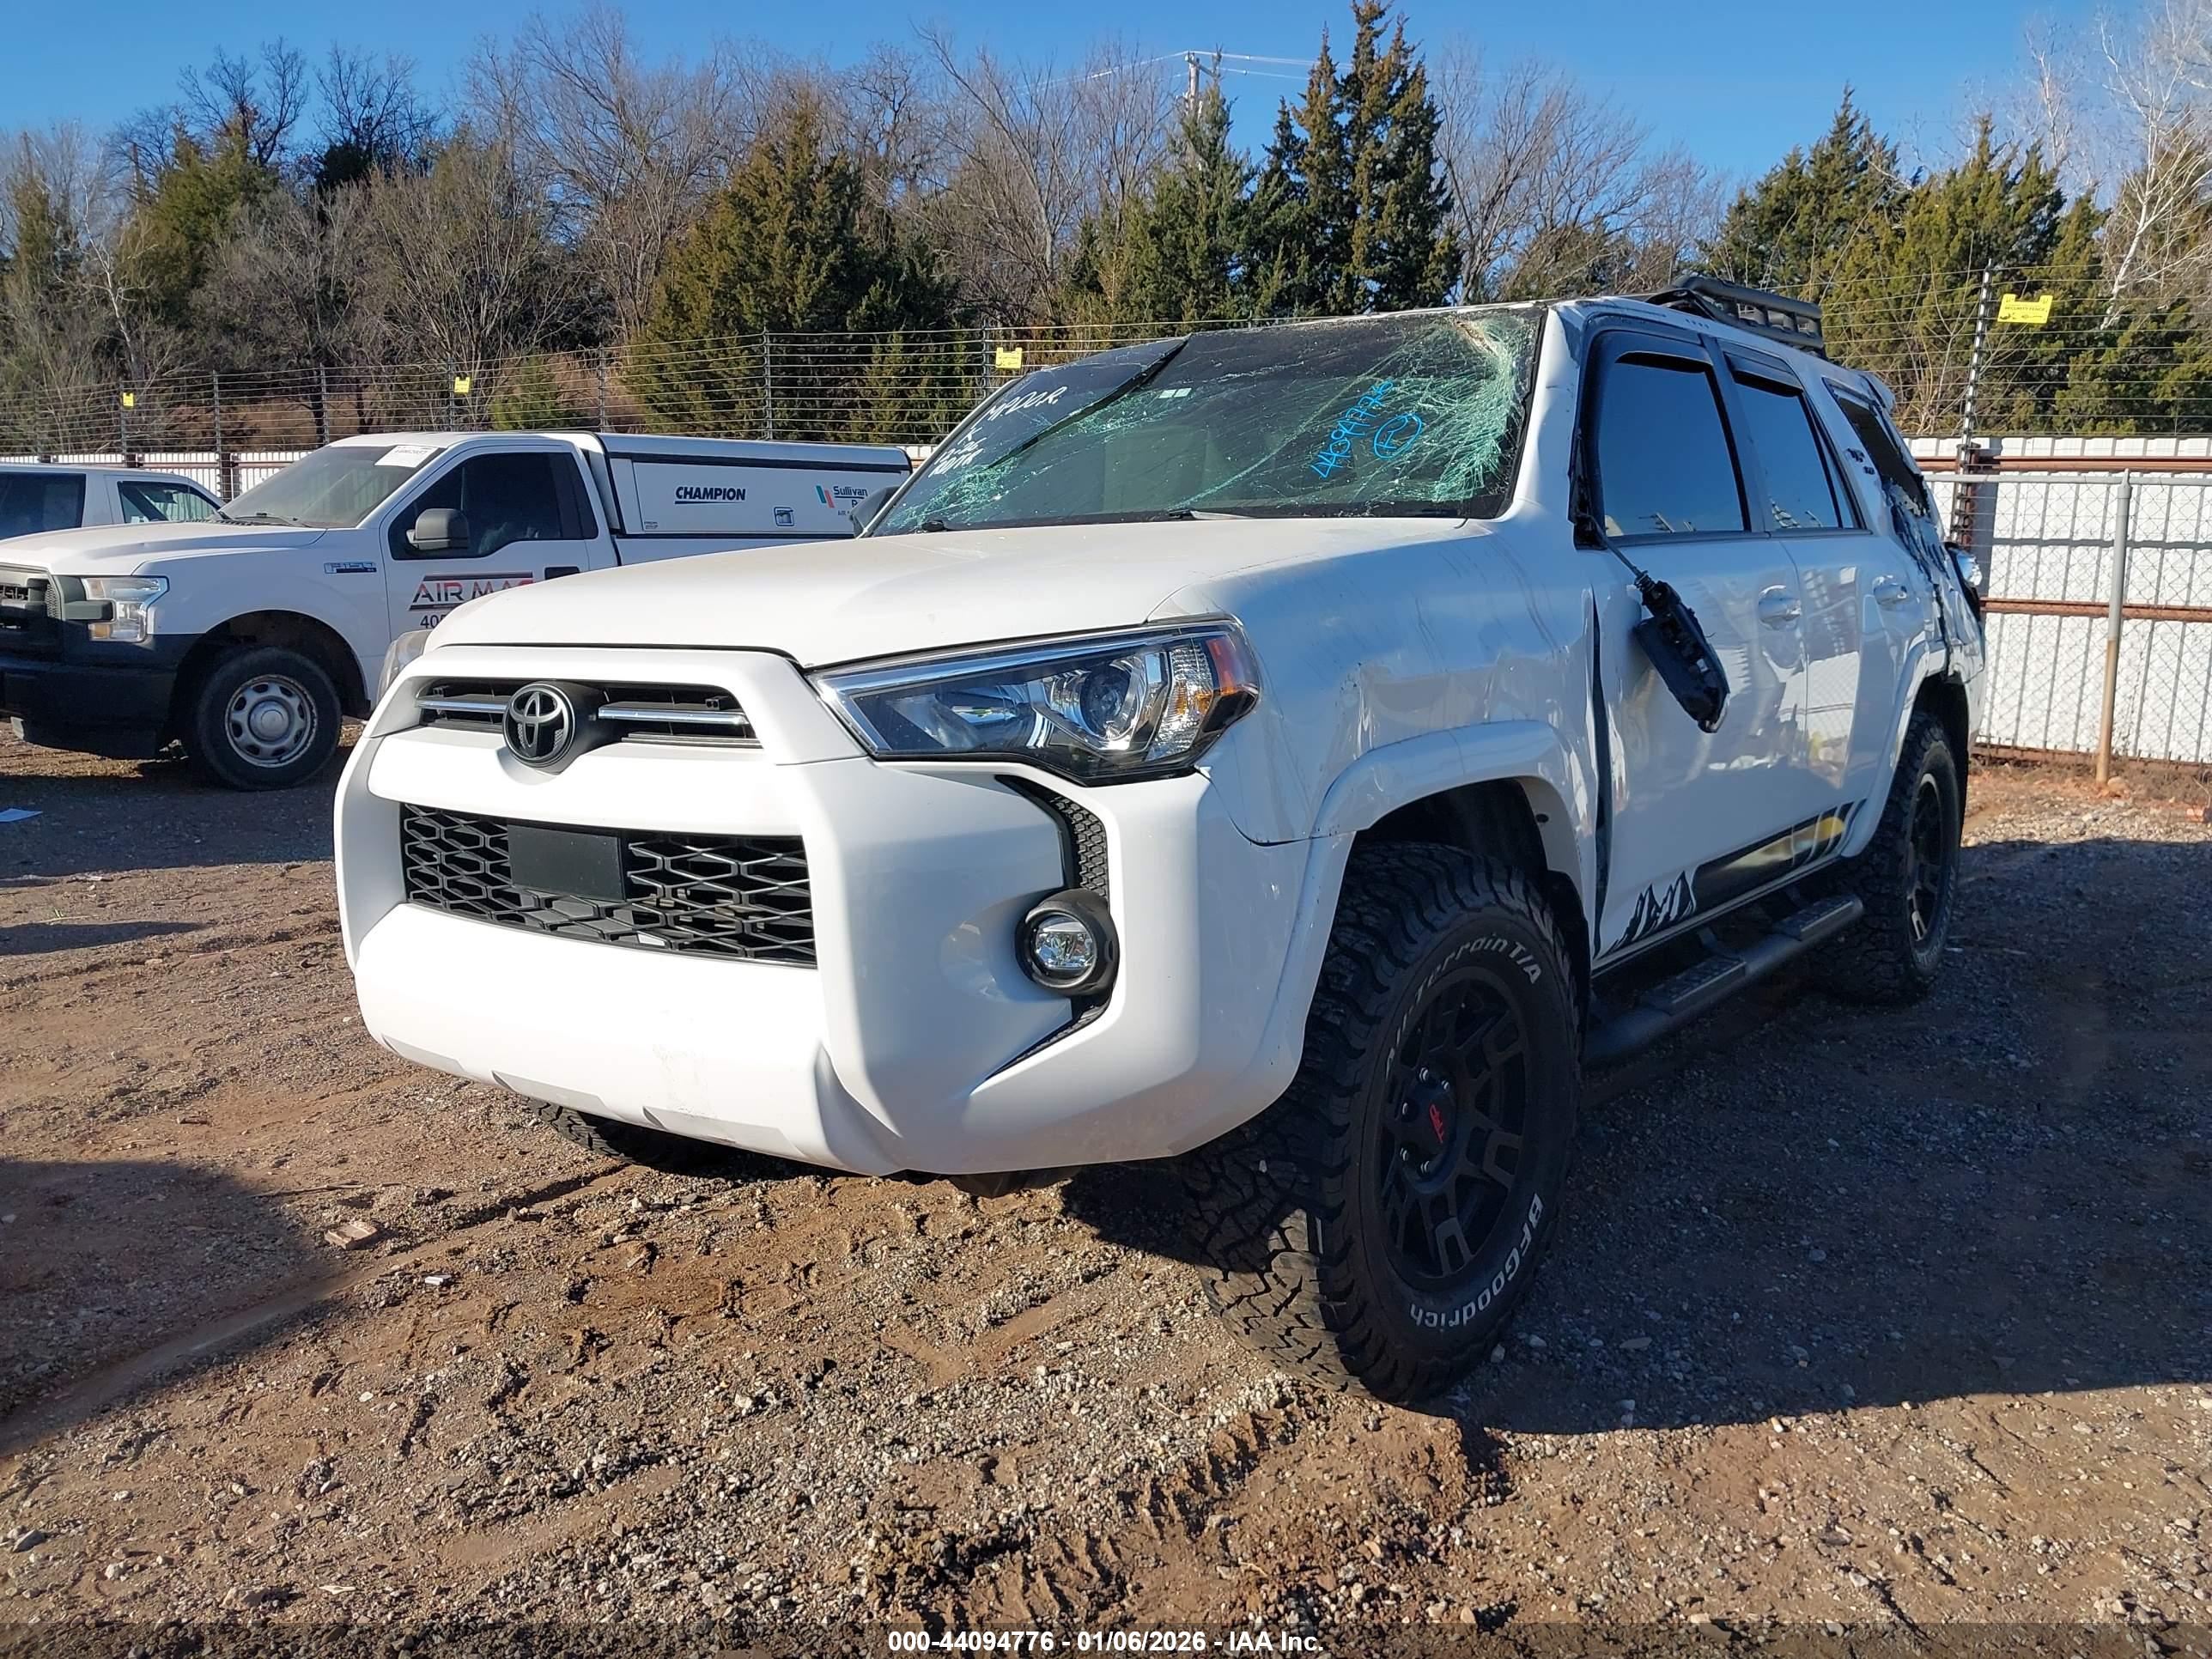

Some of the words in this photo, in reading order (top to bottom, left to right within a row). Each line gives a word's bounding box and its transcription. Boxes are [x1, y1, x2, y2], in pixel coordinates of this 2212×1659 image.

[675, 486, 746, 501] CHAMPION
[833, 486, 868, 496] Sullivan
[412, 581, 464, 603] AIR
[1509, 941, 1542, 984] T/A
[1410, 1193, 1545, 1333] BFGoodrich
